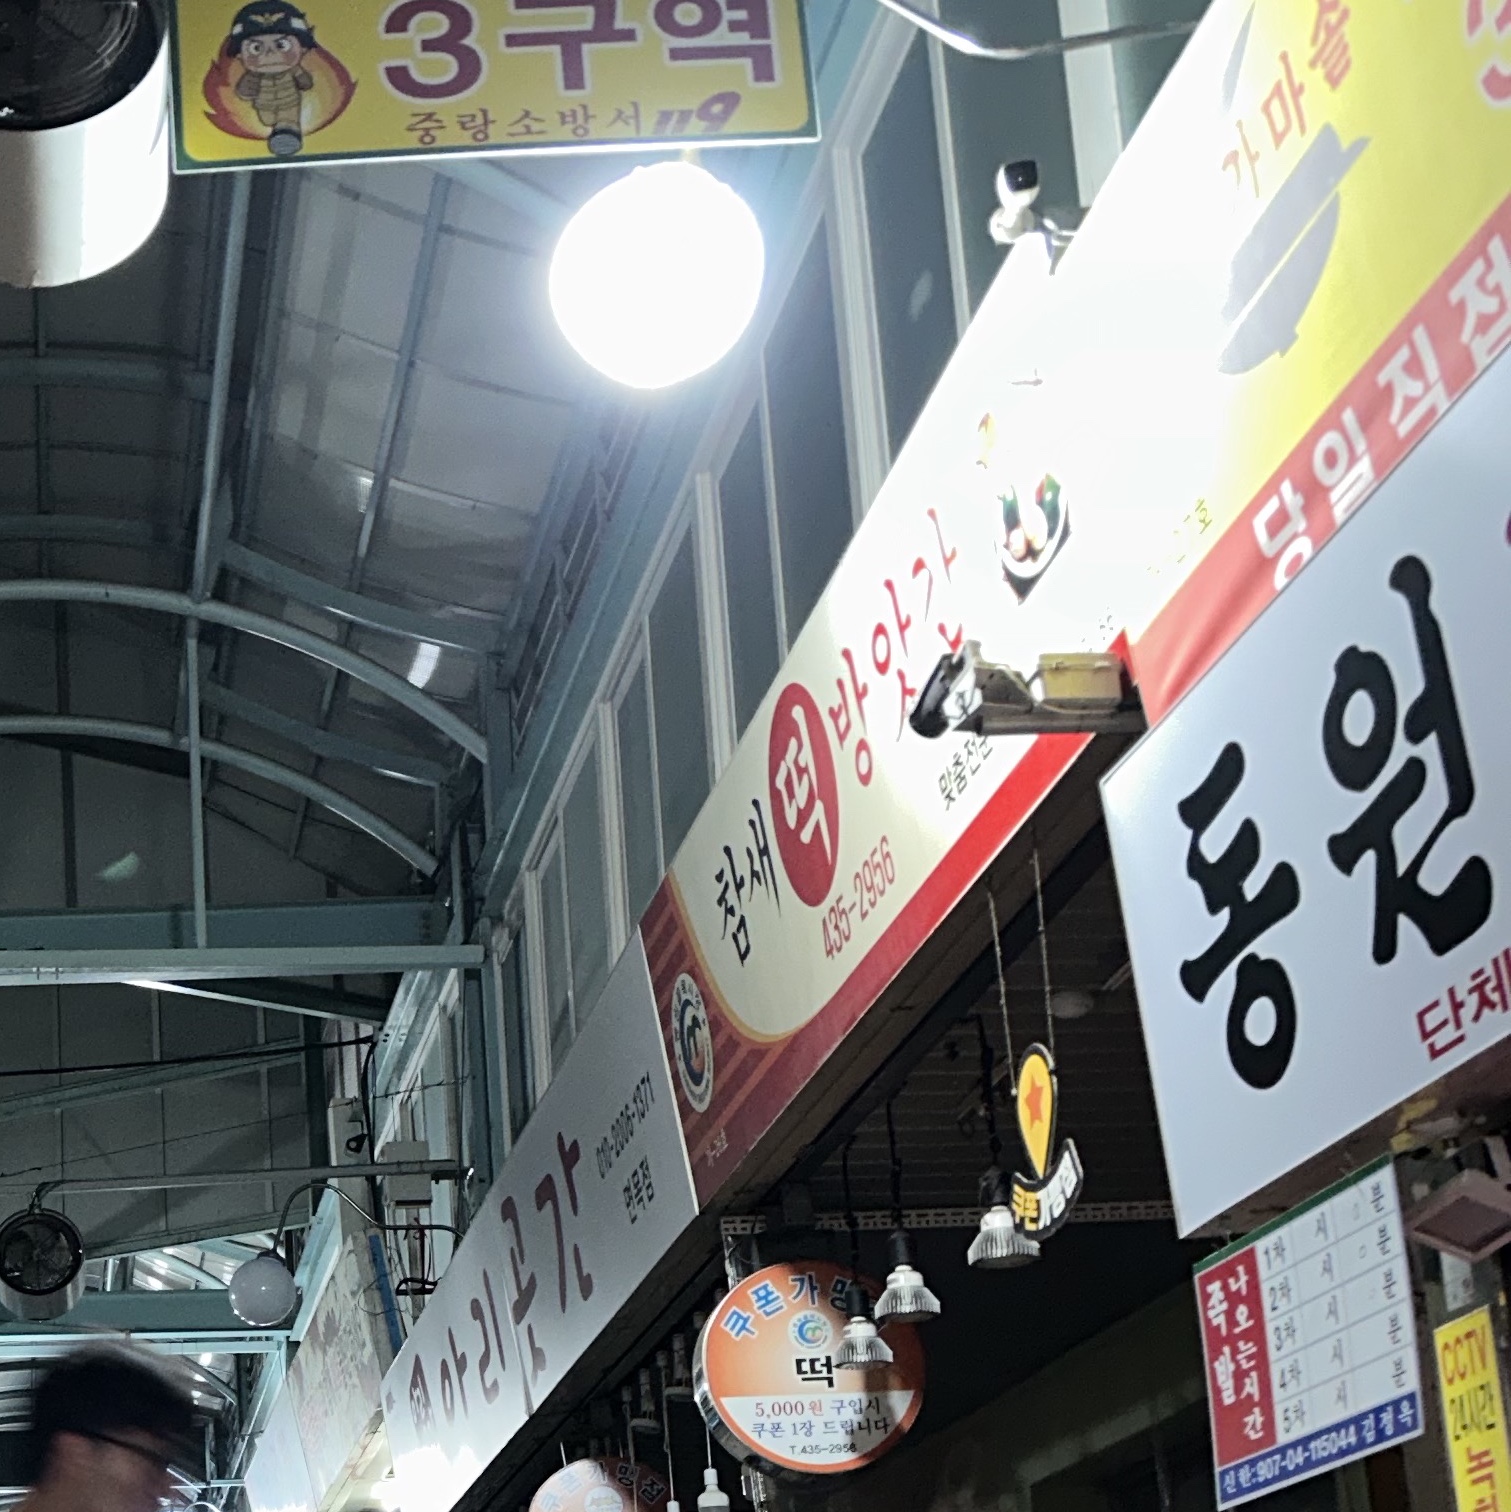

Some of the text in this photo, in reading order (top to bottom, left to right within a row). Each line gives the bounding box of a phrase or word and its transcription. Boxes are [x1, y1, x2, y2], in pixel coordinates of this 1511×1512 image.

[383, 0, 776, 98] 3구역
[405, 102, 642, 146] 중랑소방서
[1178, 554, 1493, 1089] 동원
[822, 835, 896, 960] 435-2956
[795, 1355, 835, 1390] 떡
[1441, 1324, 1487, 1385] CCTV
[751, 1417, 890, 1437] 쿠폰 1장 드립니다
[755, 1397, 881, 1417] 5,000원 구입시
